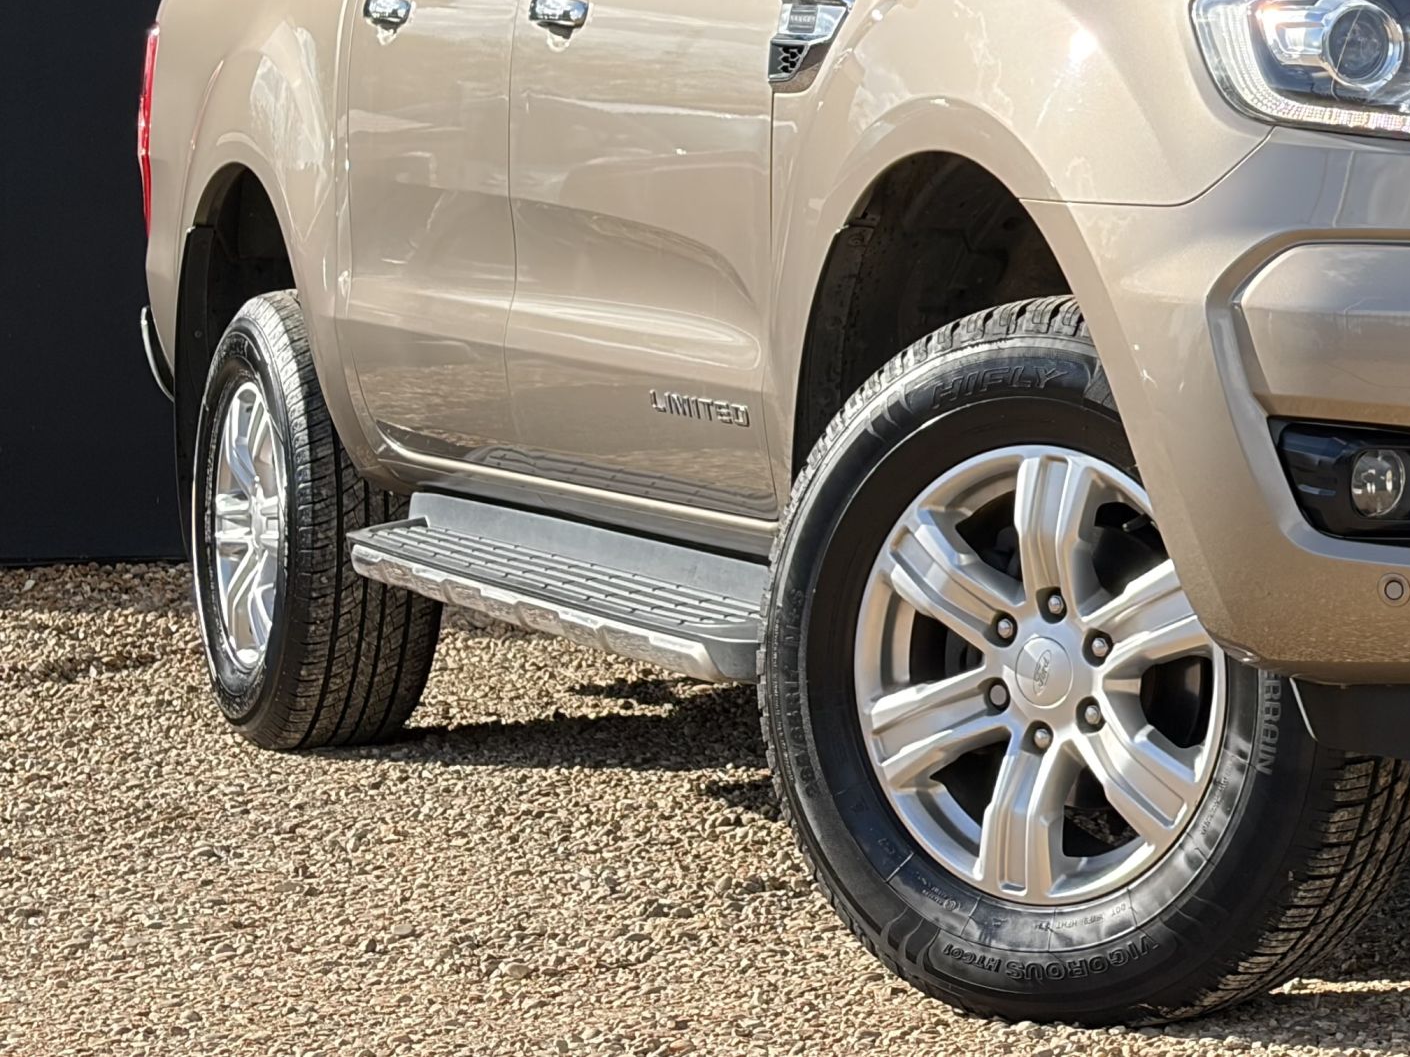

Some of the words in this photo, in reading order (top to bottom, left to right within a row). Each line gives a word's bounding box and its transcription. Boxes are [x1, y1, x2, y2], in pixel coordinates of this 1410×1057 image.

[650, 389, 750, 427] LIMITED
[931, 365, 1069, 410] HIFLY
[1005, 932, 1160, 981] VIGOROUS
